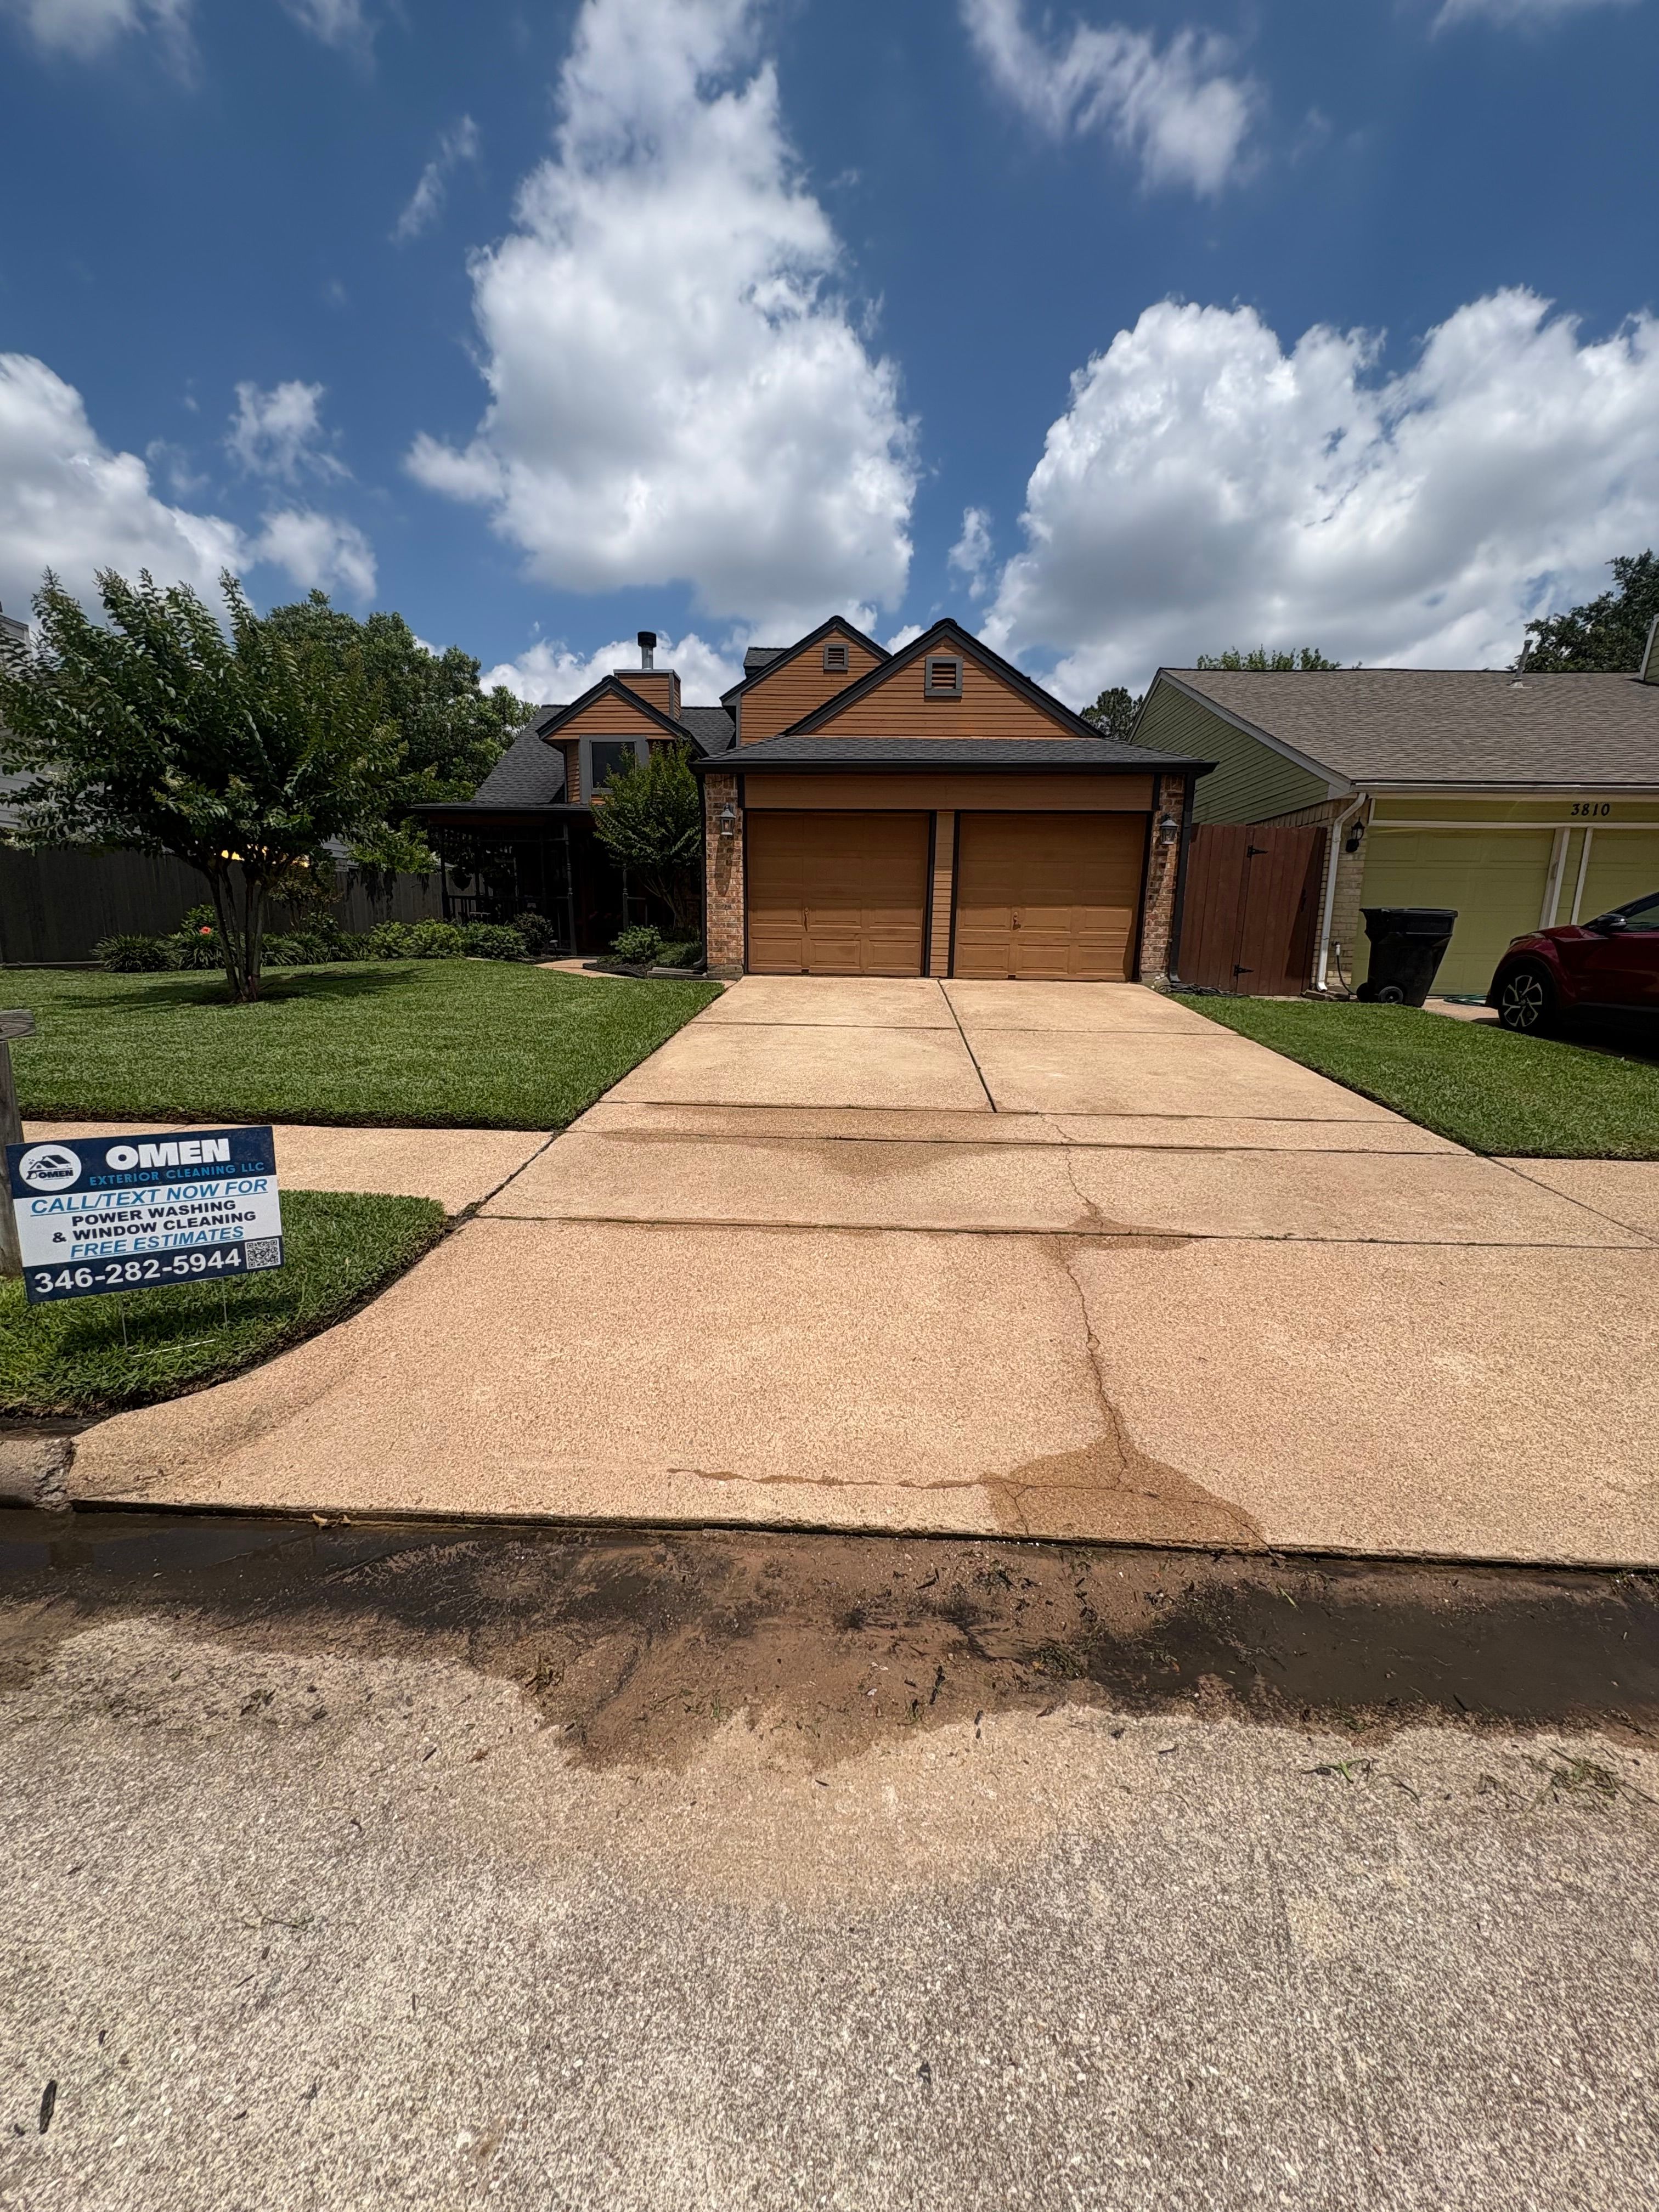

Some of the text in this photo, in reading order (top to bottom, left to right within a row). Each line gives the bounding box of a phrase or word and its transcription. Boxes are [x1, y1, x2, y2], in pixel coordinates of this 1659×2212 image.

[1571, 803, 1610, 816] 3810
[106, 1138, 231, 1170] OMEN
[38, 1170, 74, 1178] OMEN
[89, 1162, 264, 1186] EXTERIOR CLEANING LLC
[31, 1178, 268, 1214] CALL/TEXT NOW FOR
[53, 1211, 256, 1243] & WINDOW CLEANING
[72, 1200, 236, 1227] POWER WASHING
[70, 1226, 244, 1258] FREE ESTIMATES
[35, 1249, 242, 1293] 346-282-5944
